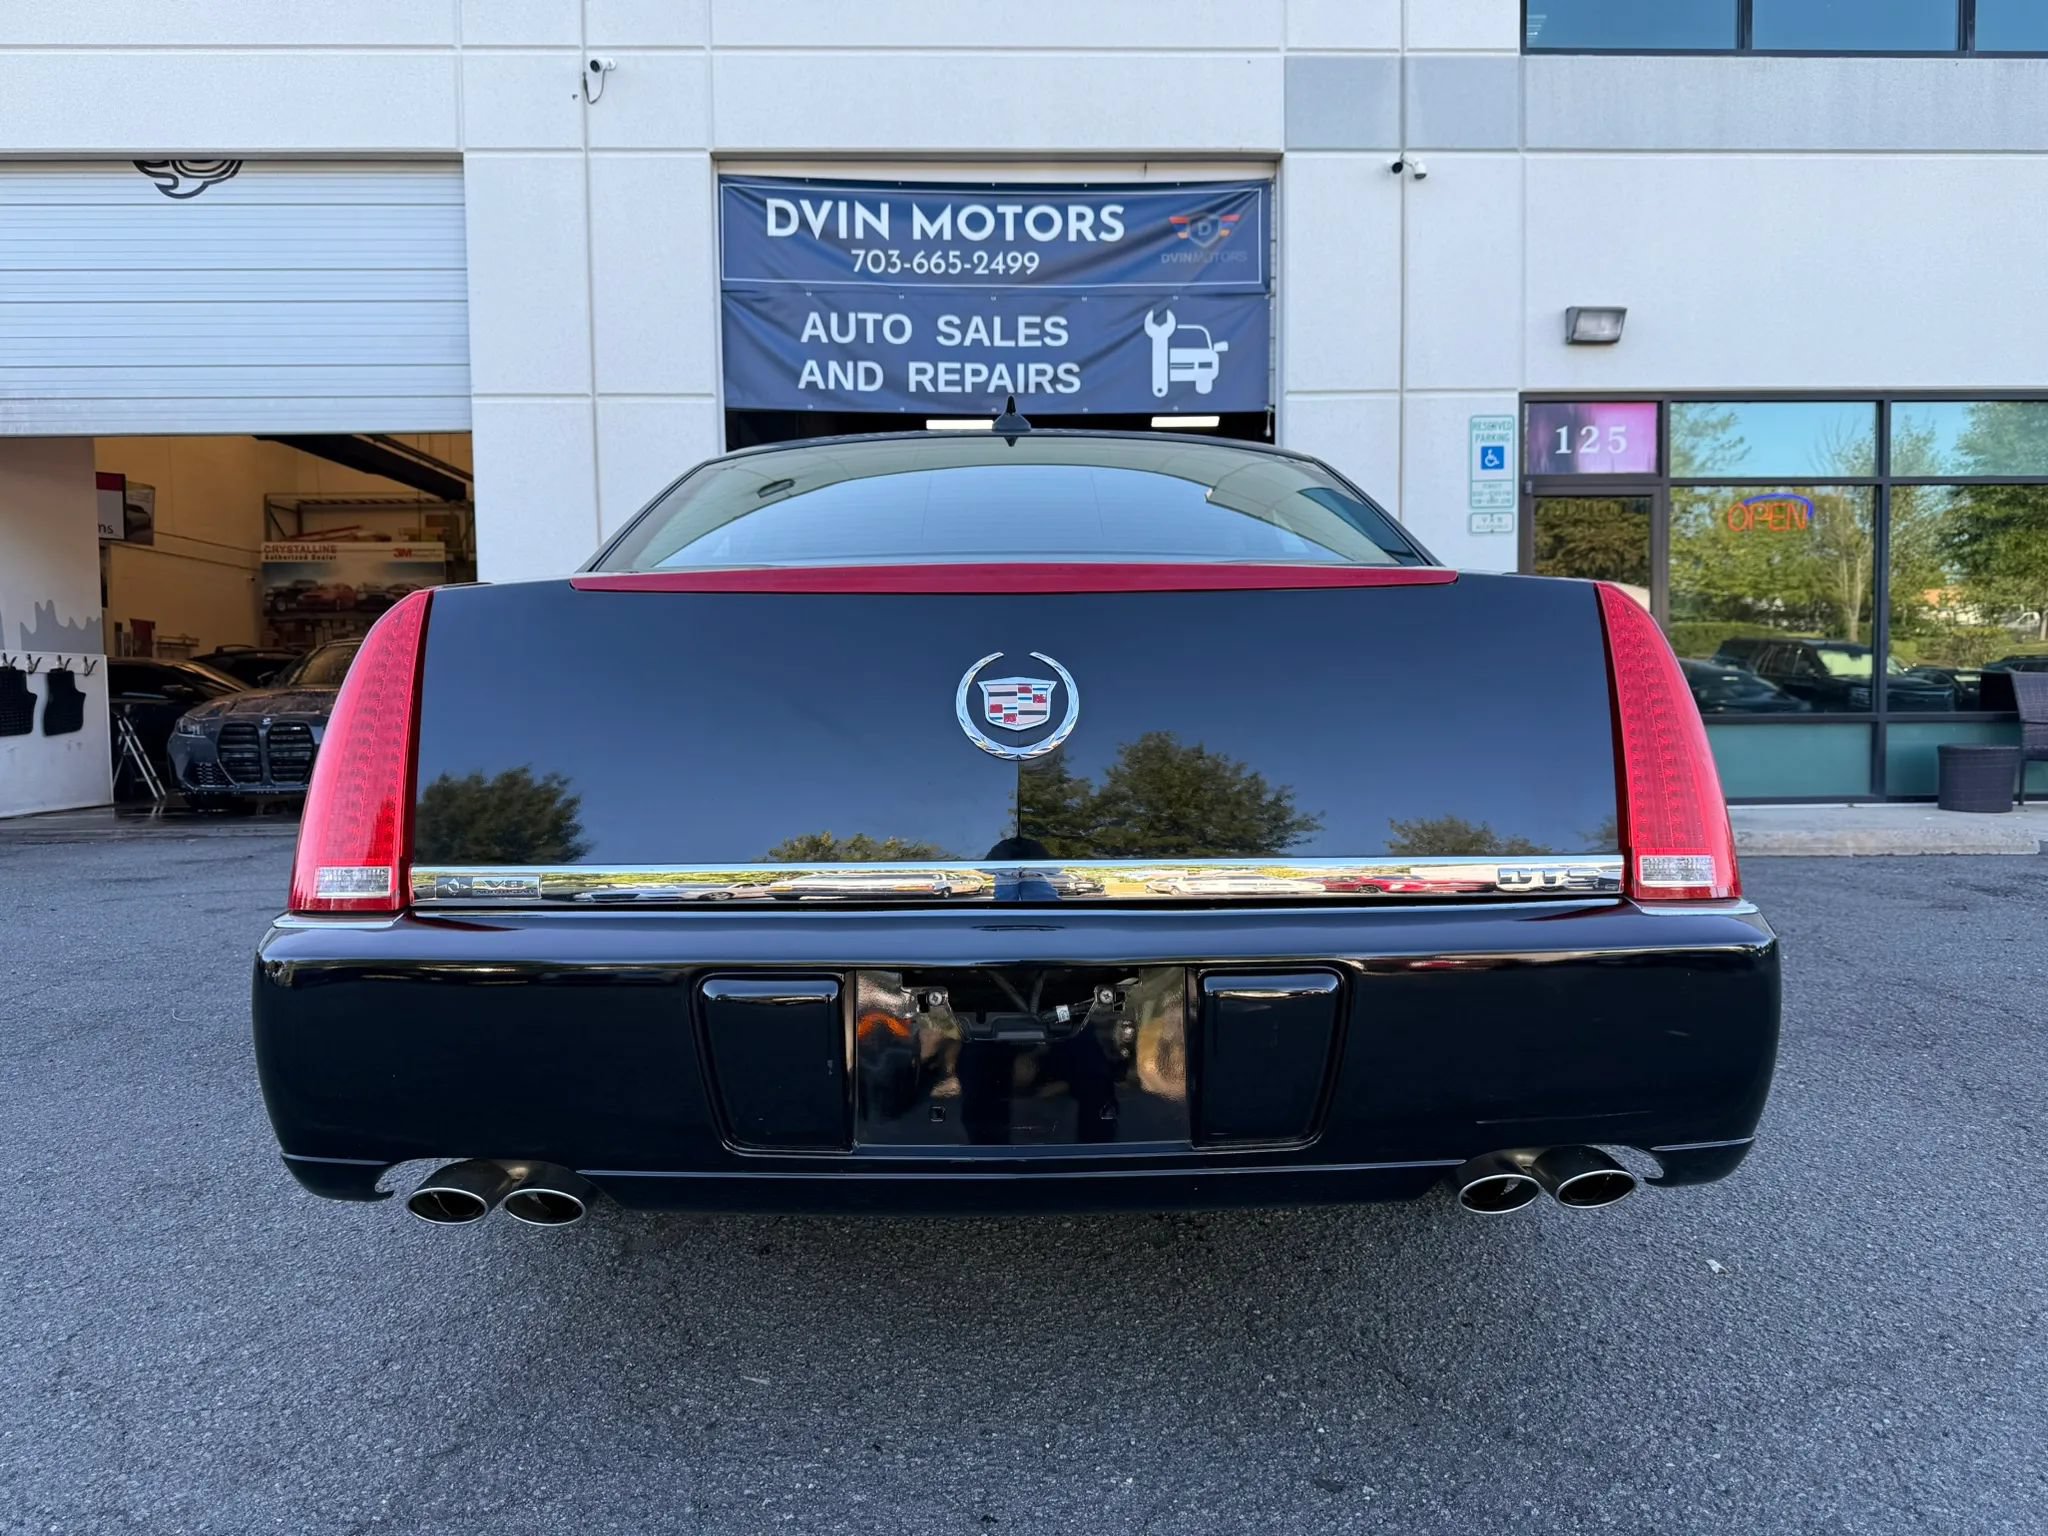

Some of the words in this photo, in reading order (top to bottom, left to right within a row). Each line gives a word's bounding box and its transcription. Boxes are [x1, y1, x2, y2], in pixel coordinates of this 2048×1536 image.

[766, 198, 890, 240] DVIN
[912, 203, 1125, 242] MOTORS
[850, 249, 1040, 275] 703-665-2499
[800, 312, 913, 345] AUTO
[936, 315, 1069, 348] SALES
[798, 360, 884, 392] AND
[908, 362, 1081, 394] REPAIRS
[1474, 433, 1510, 443] PARKING
[1555, 425, 1628, 454] 125
[1728, 502, 1808, 532] OPEN
[263, 544, 337, 554] CRYSTALLINE
[393, 548, 412, 558] 3M
